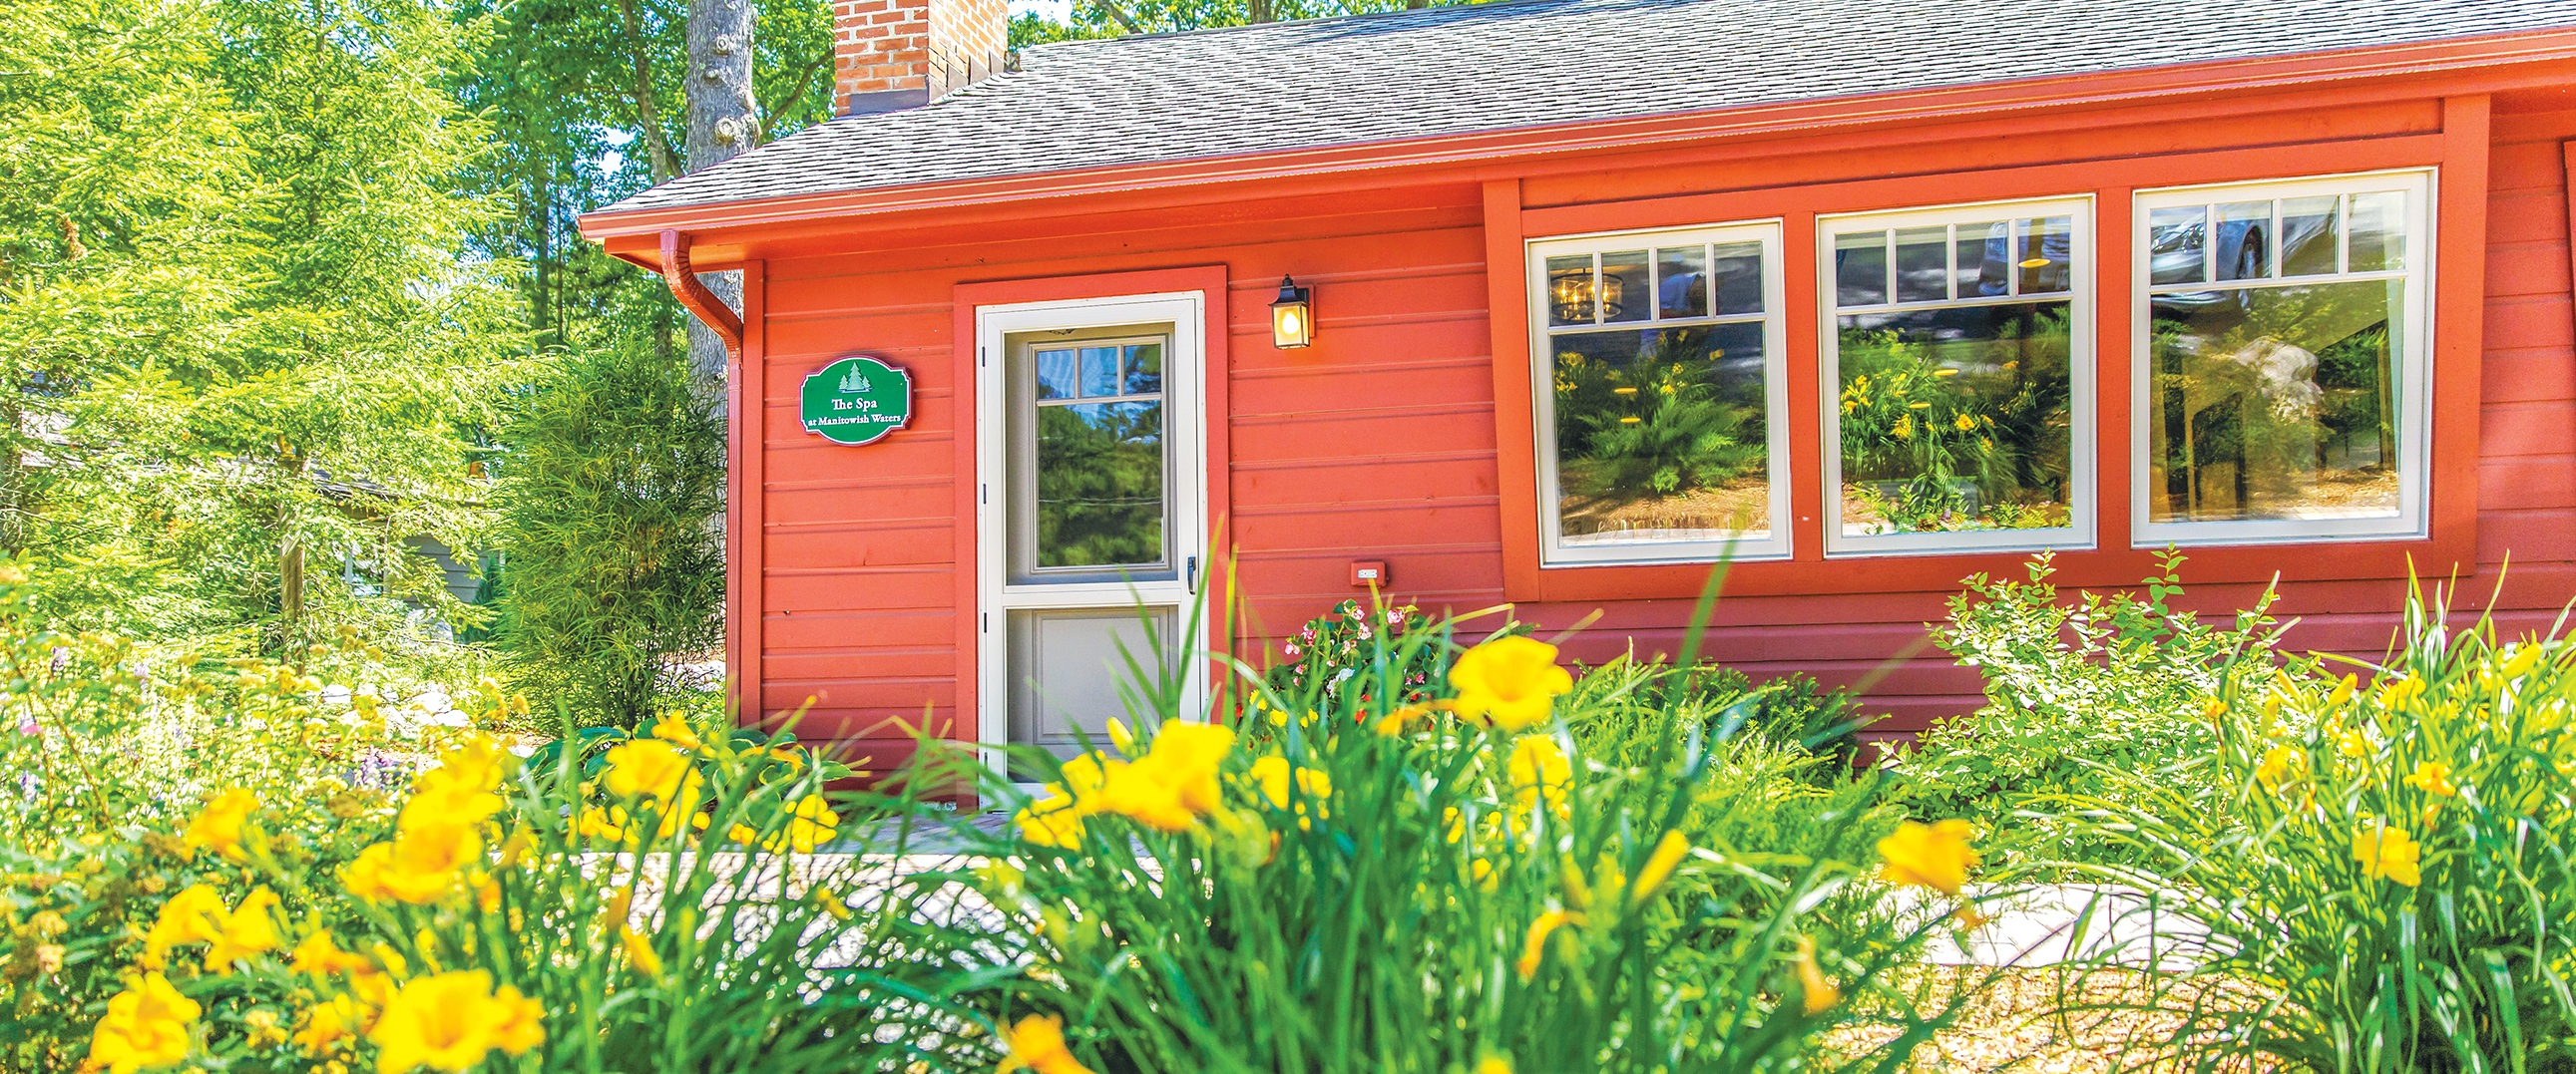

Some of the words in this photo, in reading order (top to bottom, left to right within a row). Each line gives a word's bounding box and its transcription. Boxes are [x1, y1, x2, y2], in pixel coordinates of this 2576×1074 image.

[831, 398, 853, 410] The
[855, 398, 877, 412] Spa
[817, 414, 869, 425] Manitowish
[871, 414, 901, 423] Waters
